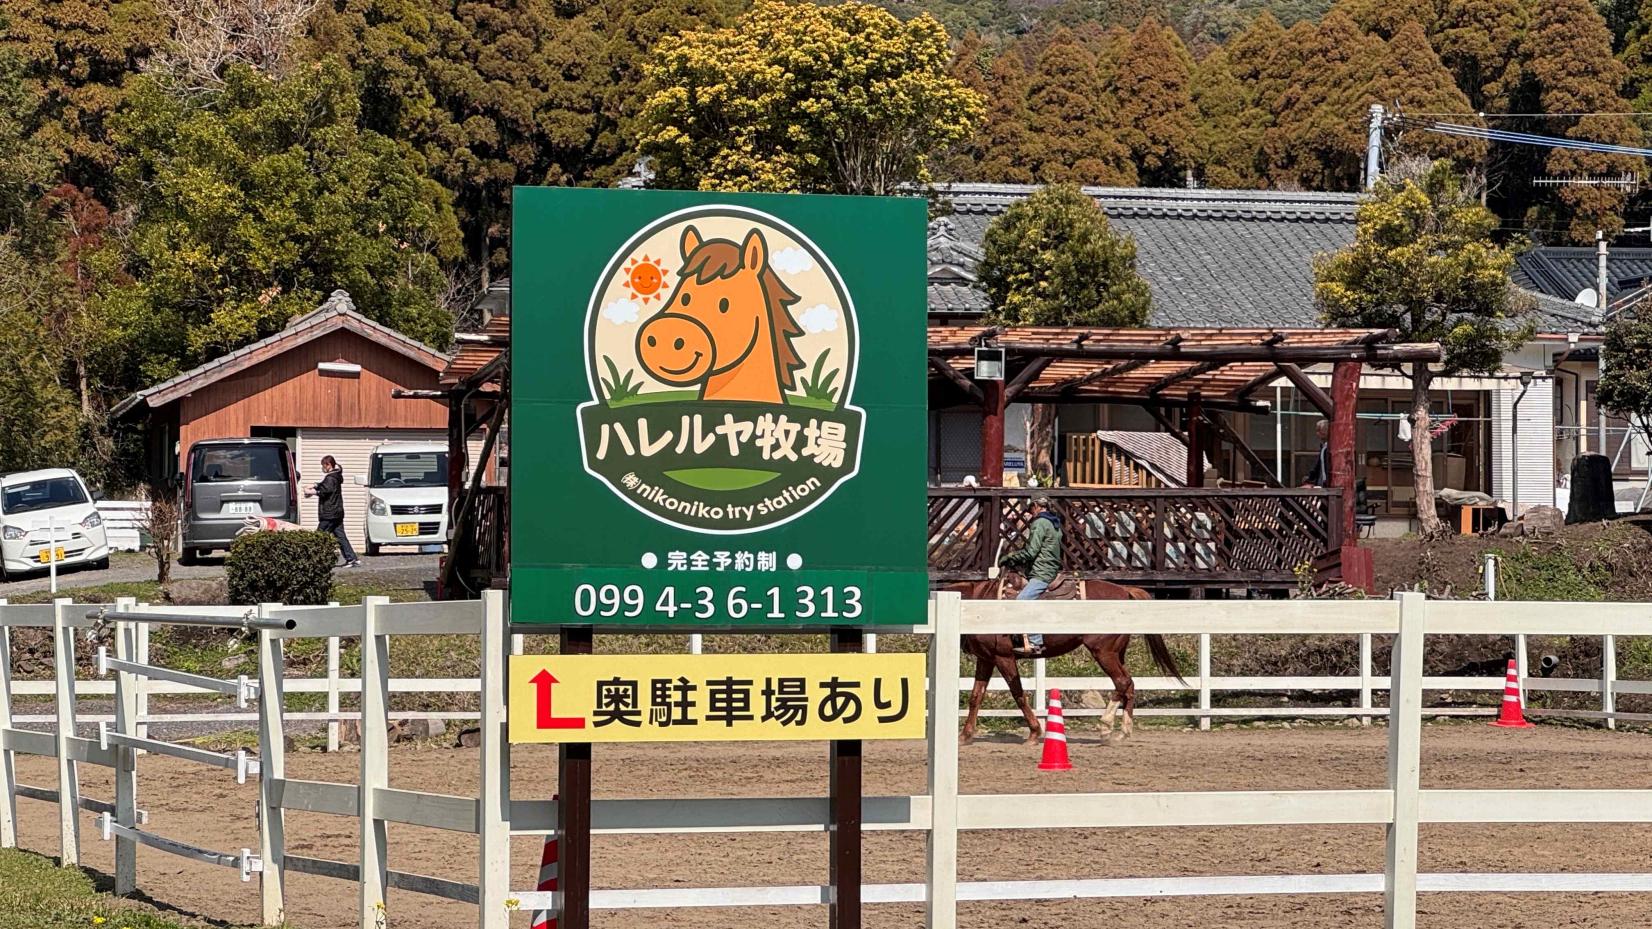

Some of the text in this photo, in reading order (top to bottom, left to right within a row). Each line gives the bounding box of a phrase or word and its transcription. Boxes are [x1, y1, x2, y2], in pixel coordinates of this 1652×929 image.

[596, 412, 847, 469] ハレルヤ牧場
[726, 503, 755, 521] try
[757, 476, 822, 516] station
[667, 550, 777, 572] 完全予約制
[592, 676, 909, 728] 奥駐車場あり
